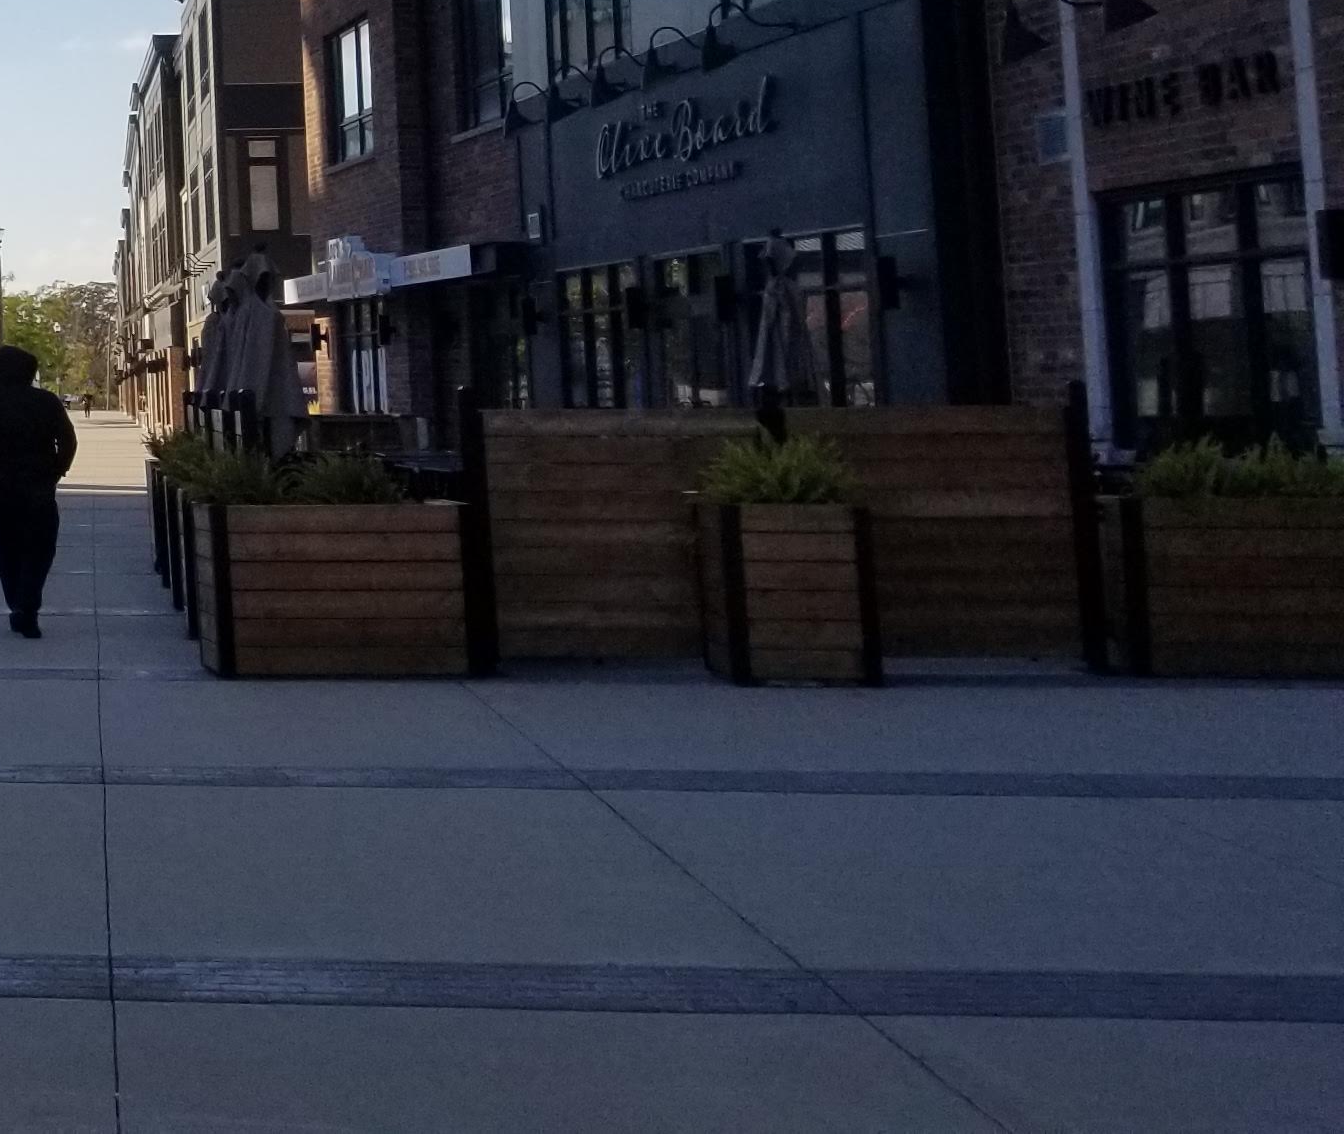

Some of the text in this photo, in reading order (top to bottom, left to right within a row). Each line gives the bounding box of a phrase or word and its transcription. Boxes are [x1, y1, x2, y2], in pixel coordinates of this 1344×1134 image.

[595, 73, 774, 179] Olive Board
[640, 102, 659, 118] THE
[1086, 50, 1282, 126] WINE BAR
